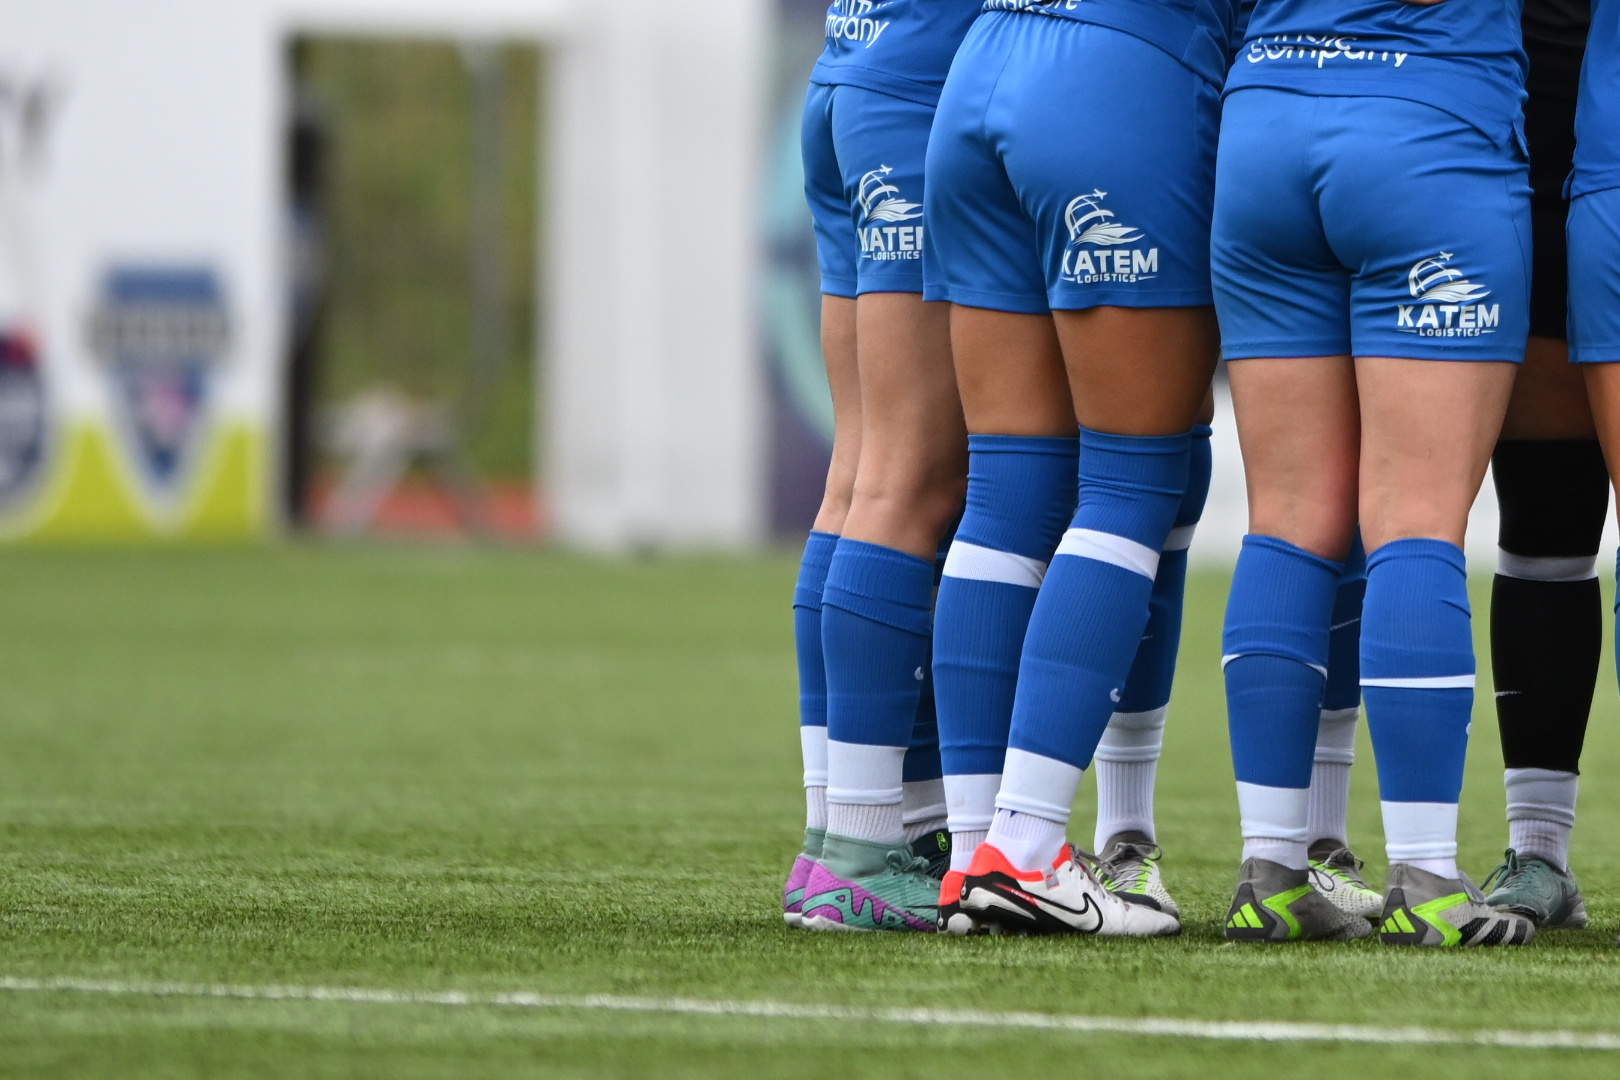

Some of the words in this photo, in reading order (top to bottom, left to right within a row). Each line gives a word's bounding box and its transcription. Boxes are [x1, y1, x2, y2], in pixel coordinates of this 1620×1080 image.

[825, 15, 890, 49] mpany
[872, 251, 920, 261] LOGISTICS
[1061, 248, 1158, 276] KATEM
[1077, 273, 1137, 284] LOGISTICS
[1397, 304, 1500, 329] KATEM
[1419, 328, 1480, 337] LOGISTICS
